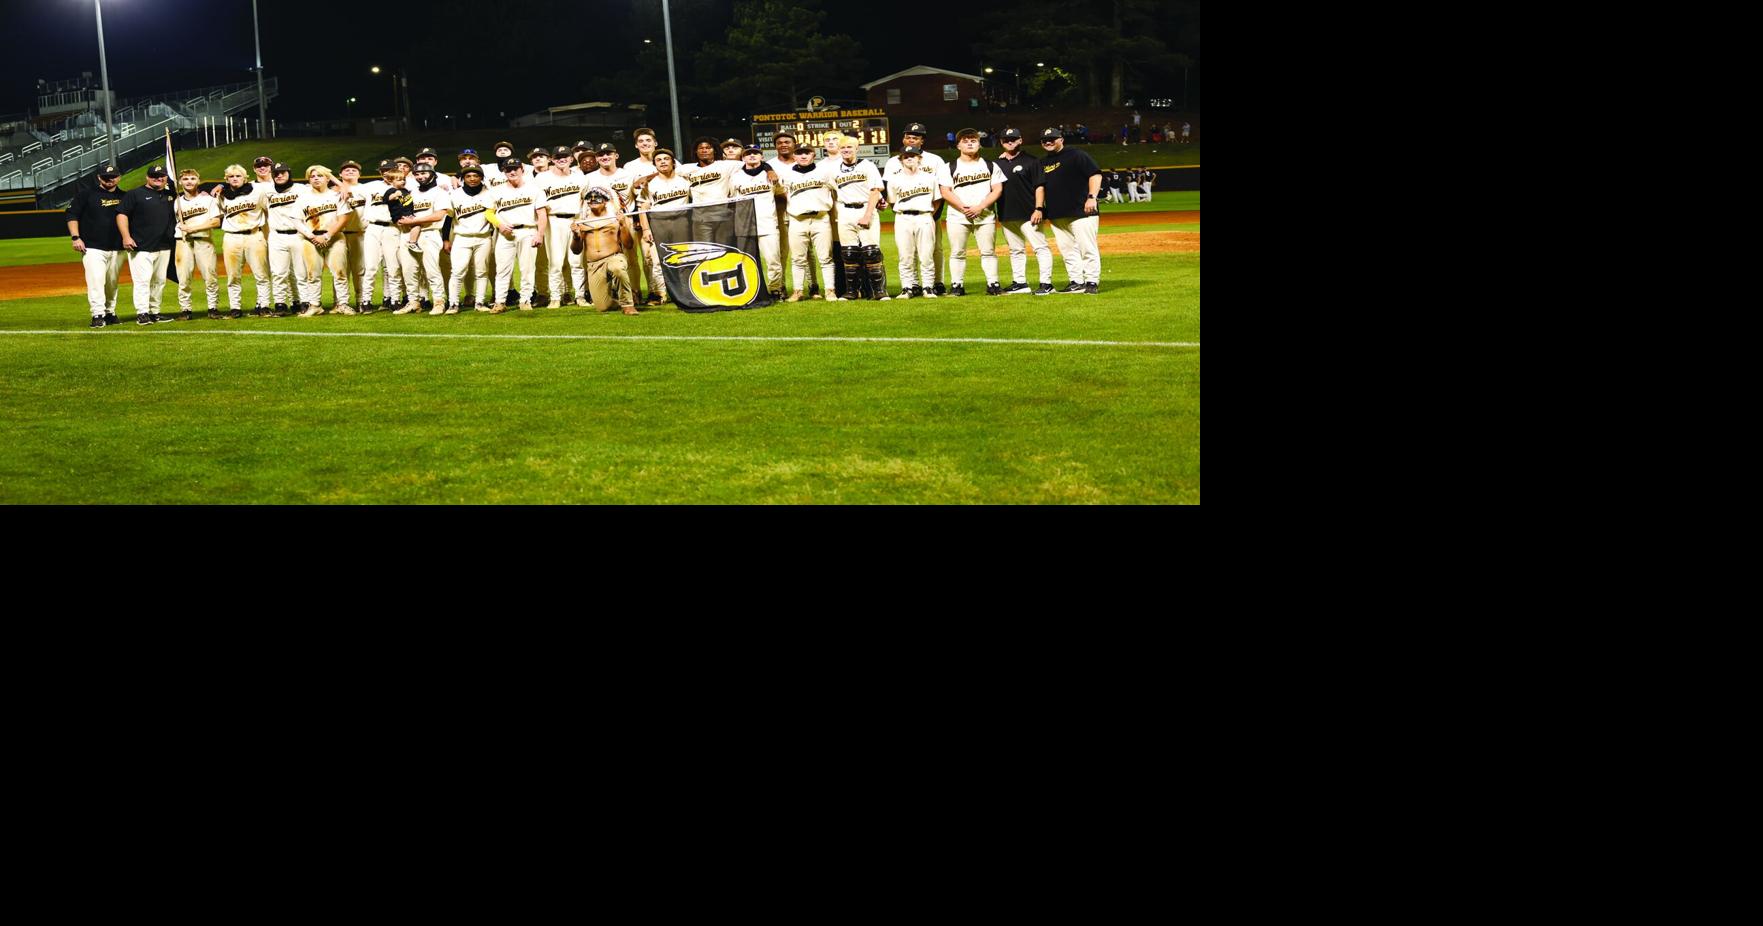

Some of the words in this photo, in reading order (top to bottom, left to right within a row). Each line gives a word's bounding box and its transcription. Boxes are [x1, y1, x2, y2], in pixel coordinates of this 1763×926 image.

[753, 113, 796, 121] PONTOTOC
[800, 111, 838, 119] WARRIOR
[841, 109, 885, 117] BASEBALL
[797, 122, 804, 131] 0
[852, 120, 860, 128] 2
[953, 172, 992, 184] Warriors
[544, 185, 580, 197] Warriors
[653, 188, 689, 201] Warriors
[496, 197, 532, 208] Warriors
[302, 203, 337, 217] Warriors
[454, 203, 483, 216] Warrio
[700, 262, 748, 299] P
